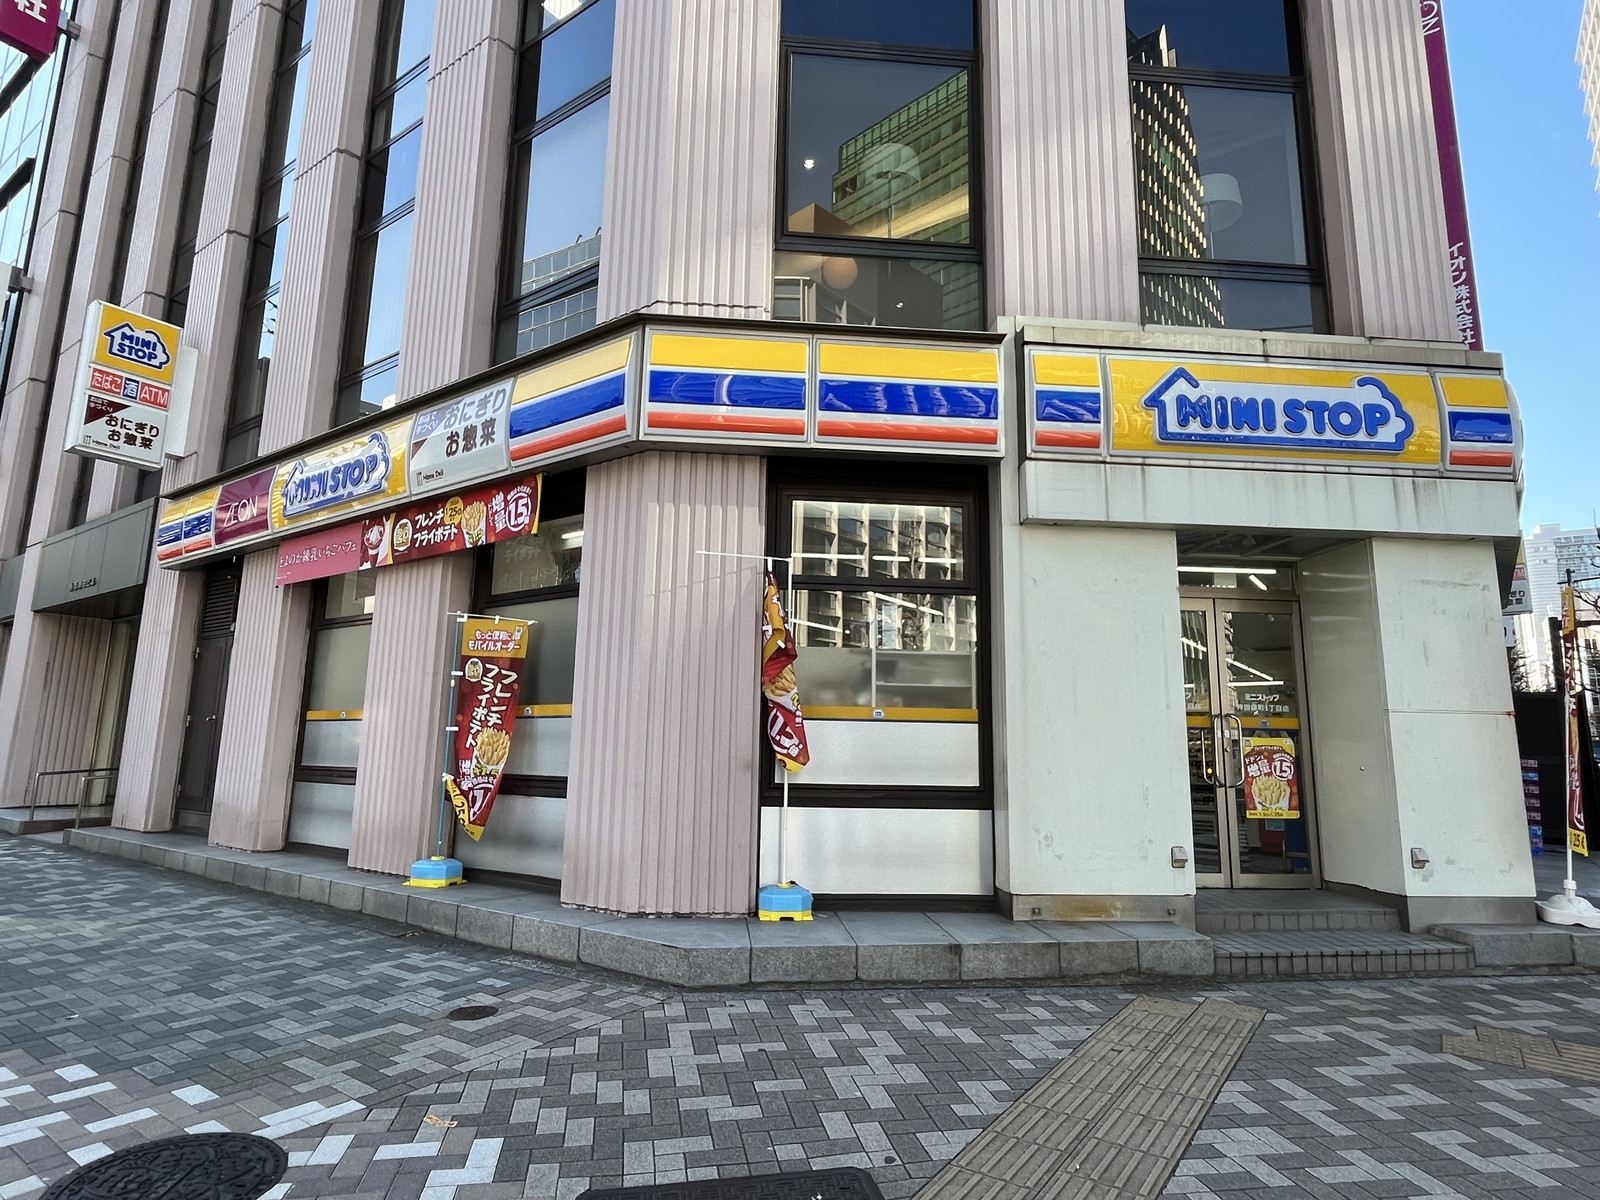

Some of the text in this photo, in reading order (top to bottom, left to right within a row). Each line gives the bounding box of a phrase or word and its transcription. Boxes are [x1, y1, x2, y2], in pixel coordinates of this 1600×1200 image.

[1449, 242, 1476, 344] イオン株式会社
[117, 344, 157, 362] STOP
[120, 331, 157, 351] MINI
[91, 371, 168, 407] たばこ 酒 ATM
[444, 388, 507, 430] おにぎり
[1175, 392, 1391, 437] MINI STOP
[105, 414, 160, 437] おにぎり
[445, 417, 497, 457] お惣菜
[107, 429, 154, 450] お惣菜
[290, 451, 379, 507] MINI STOP
[414, 508, 445, 529] フレンチ
[413, 523, 459, 548] フライポテト
[468, 640, 521, 652] モバイルオーダー
[475, 630, 511, 641] もっと便利に
[465, 663, 500, 748] フライポテト
[486, 668, 518, 727] フレンチ
[1244, 693, 1280, 702] ミニストップ
[1247, 759, 1271, 777] 増量
